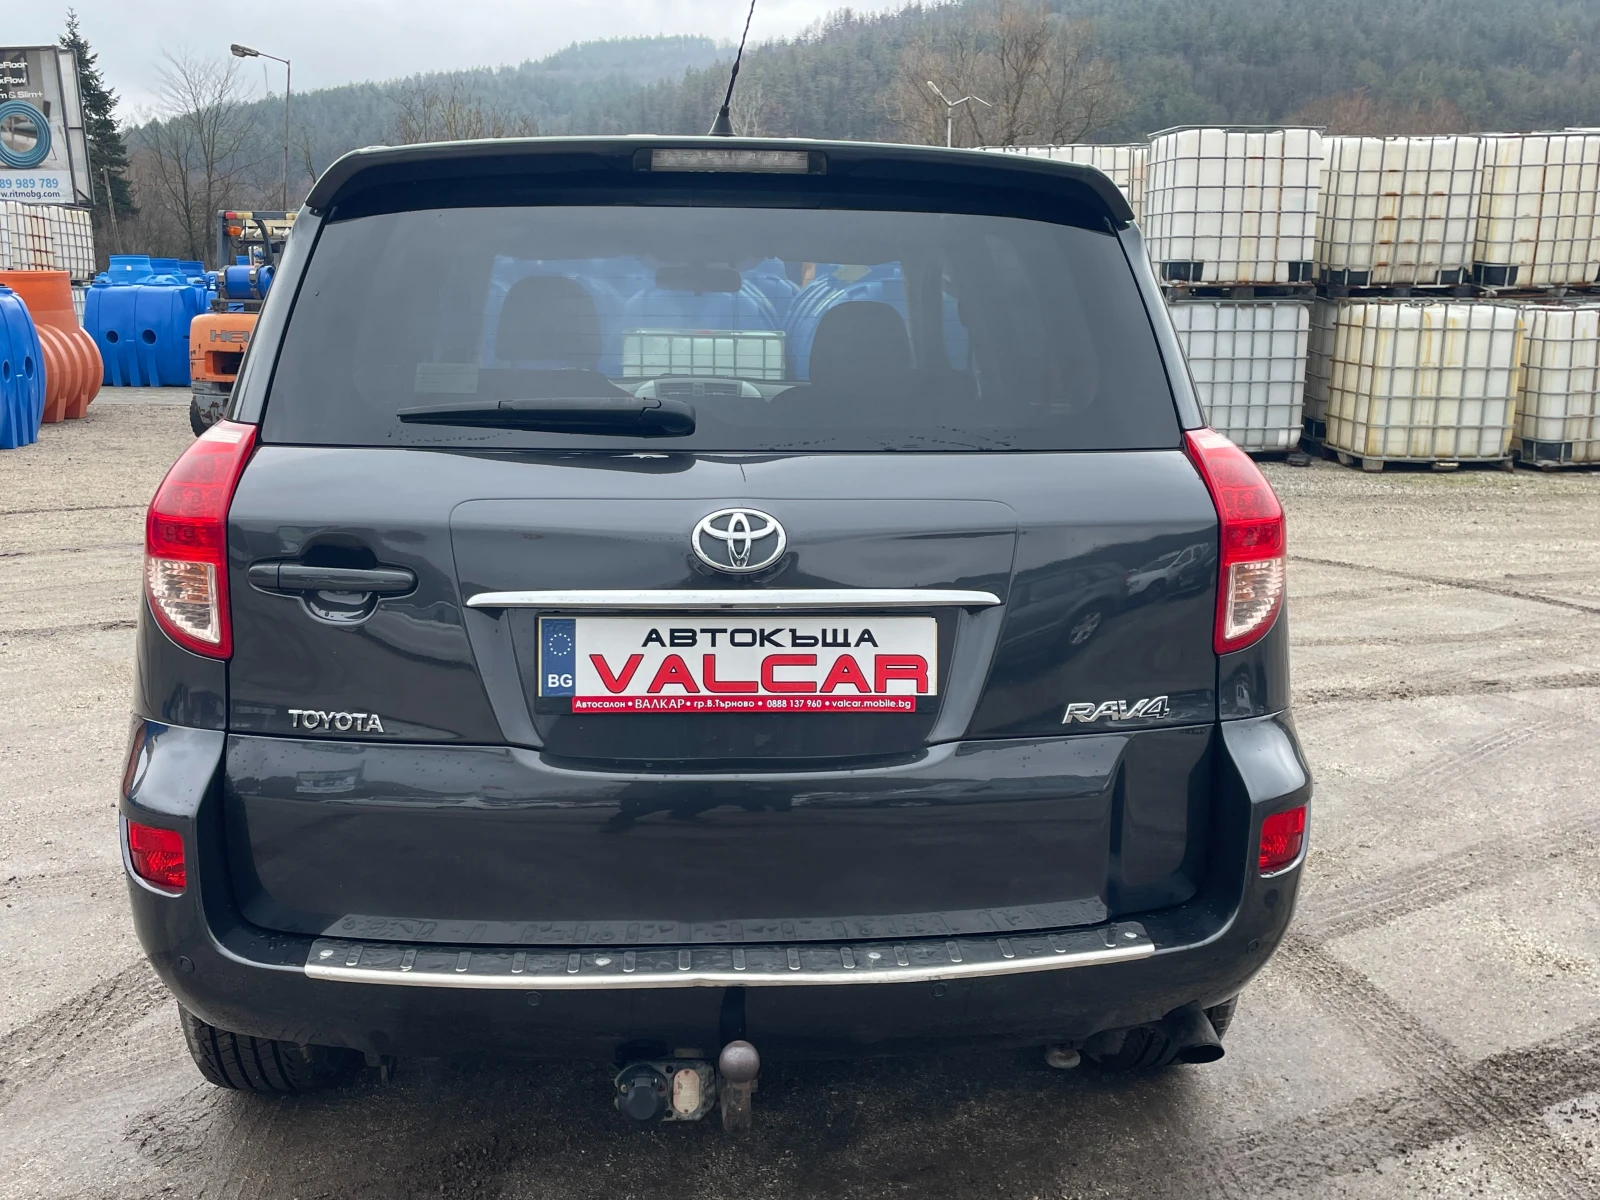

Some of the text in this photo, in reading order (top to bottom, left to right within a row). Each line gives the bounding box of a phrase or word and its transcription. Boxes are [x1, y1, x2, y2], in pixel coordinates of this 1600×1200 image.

[15, 178, 36, 189] 989
[38, 178, 59, 189] 789
[641, 628, 879, 648] АВТОКЪЩА
[547, 674, 573, 688] BG
[589, 653, 929, 694] VALCAR
[575, 700, 626, 709] Автосалон
[635, 698, 685, 709] ВАЛКАР
[766, 699, 787, 708] 0888
[790, 699, 804, 708] 137
[807, 699, 822, 708] 960
[832, 699, 911, 710] valcar.mobile.bg
[1062, 696, 1170, 724] RAV4
[288, 709, 384, 733] TOYOTA
